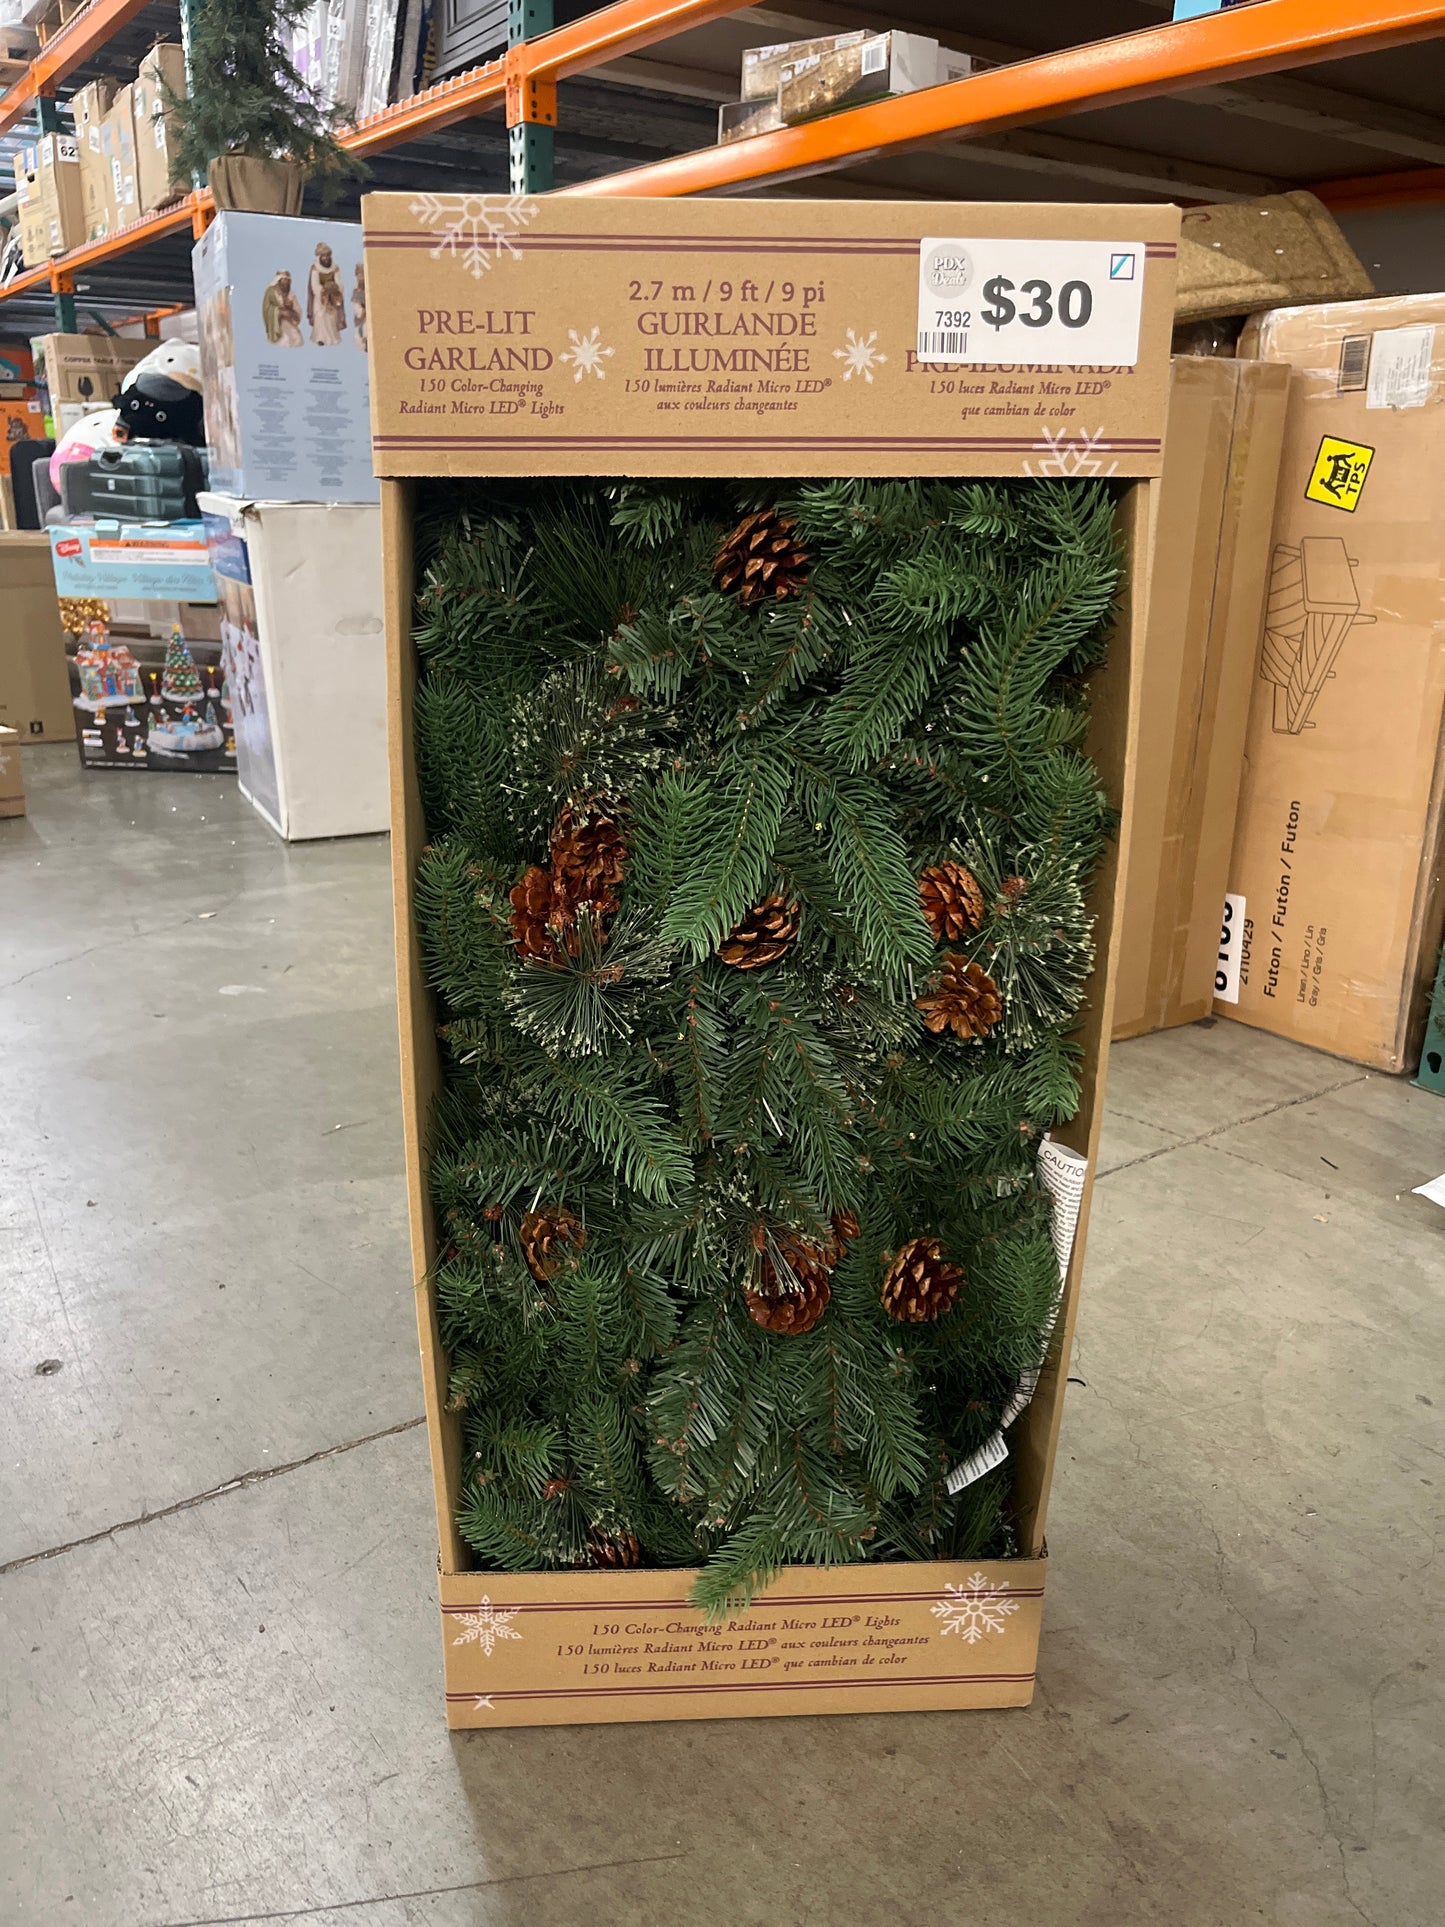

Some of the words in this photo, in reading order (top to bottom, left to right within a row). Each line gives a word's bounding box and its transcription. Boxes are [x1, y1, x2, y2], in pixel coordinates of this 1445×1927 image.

[60, 146, 78, 157] 62
[933, 257, 966, 270] PDX
[931, 271, 966, 287] Deals
[629, 280, 664, 301] 2.7
[671, 285, 696, 301] m
[702, 279, 712, 303] /
[719, 281, 733, 301] 9
[740, 279, 759, 302] ft
[764, 280, 775, 303] /
[781, 282, 795, 302] 9
[802, 281, 825, 308] pi
[980, 275, 1093, 332] $30
[417, 310, 536, 335] PRE-LIT
[637, 312, 817, 337] GUIRLANDE
[935, 311, 971, 328] 7392
[404, 346, 553, 371] GARLAND
[643, 342, 810, 372] ILLUMINÉE
[420, 378, 446, 393] 150
[450, 378, 543, 397] Color-Changing
[624, 379, 650, 393] 150
[654, 379, 702, 393] lumières
[706, 379, 753, 393] Radiant
[757, 380, 791, 393] Micro
[930, 380, 954, 394] 150
[958, 380, 985, 394] luces
[988, 380, 1034, 395] Radiant
[1038, 381, 1071, 395] Micro
[399, 400, 446, 414] Radiant
[450, 400, 485, 414] Micro
[530, 401, 565, 419] Lights
[656, 400, 680, 411] aux
[684, 396, 730, 411] couleurs
[734, 397, 799, 415] changeantes
[961, 405, 980, 420] que
[983, 402, 1029, 416] cambian
[1033, 402, 1047, 416] de
[1049, 402, 1076, 416] color
[1346, 462, 1366, 495] TPS
[1281, 800, 1300, 853] Futon
[1272, 874, 1291, 927] Futón
[1306, 925, 1314, 940] Lin
[1316, 927, 1327, 946] Gris
[1239, 919, 1254, 985] 2110429
[1301, 950, 1311, 970] Lino
[1263, 947, 1282, 998] Futon
[1313, 956, 1323, 975] Gris
[1297, 975, 1308, 1003] Linen
[1309, 986, 1320, 1007] Gray
[593, 1624, 620, 1635] 150
[625, 1622, 722, 1636] Color-Changing
[726, 1620, 776, 1632] Radiant
[781, 1619, 816, 1630] Micro
[864, 1615, 901, 1630] Lights
[557, 1645, 584, 1656] 150
[588, 1644, 639, 1655] lumières
[643, 1642, 693, 1654] Radiant
[698, 1641, 733, 1652] Micro
[781, 1641, 805, 1649] aux
[809, 1636, 858, 1648] couleurs
[862, 1635, 930, 1648] changeantes
[583, 1663, 610, 1674] 150
[614, 1662, 642, 1674] luces
[647, 1661, 697, 1673] Radiant
[701, 1659, 736, 1671] Micro
[783, 1660, 804, 1671] que
[808, 1655, 857, 1667] cambian
[862, 1654, 875, 1665] de
[879, 1653, 908, 1665] color
